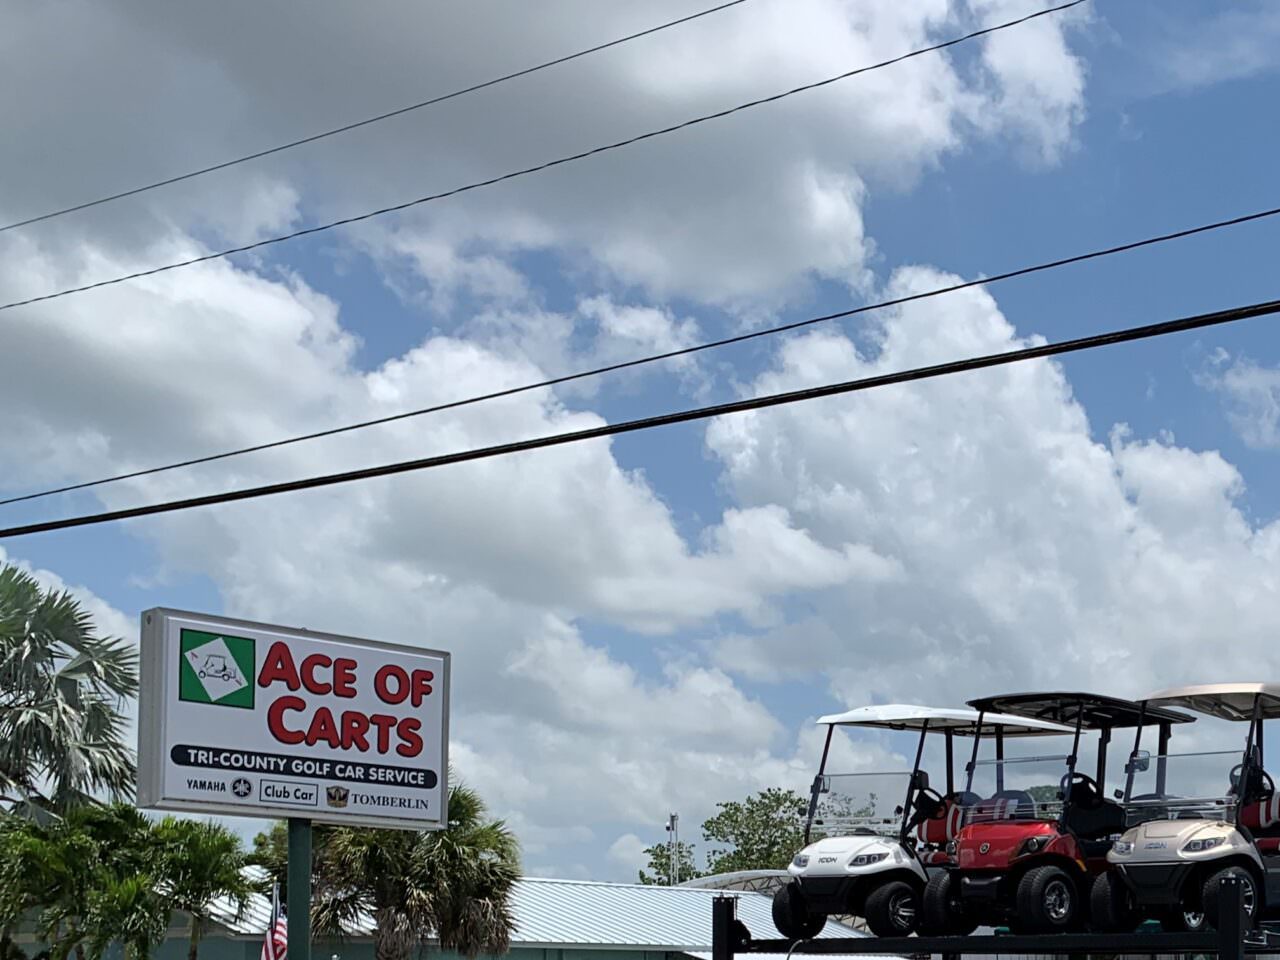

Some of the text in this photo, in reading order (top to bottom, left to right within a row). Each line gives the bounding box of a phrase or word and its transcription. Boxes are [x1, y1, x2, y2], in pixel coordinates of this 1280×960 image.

[257, 640, 434, 708] ACE OF
[267, 695, 424, 758] CARTS
[187, 749, 425, 785] TRI-COUNTY GOLF CAR SERVICE
[187, 779, 226, 792] YAMAHA
[264, 785, 314, 801] Club Car
[351, 793, 429, 810] TOMBERLIN
